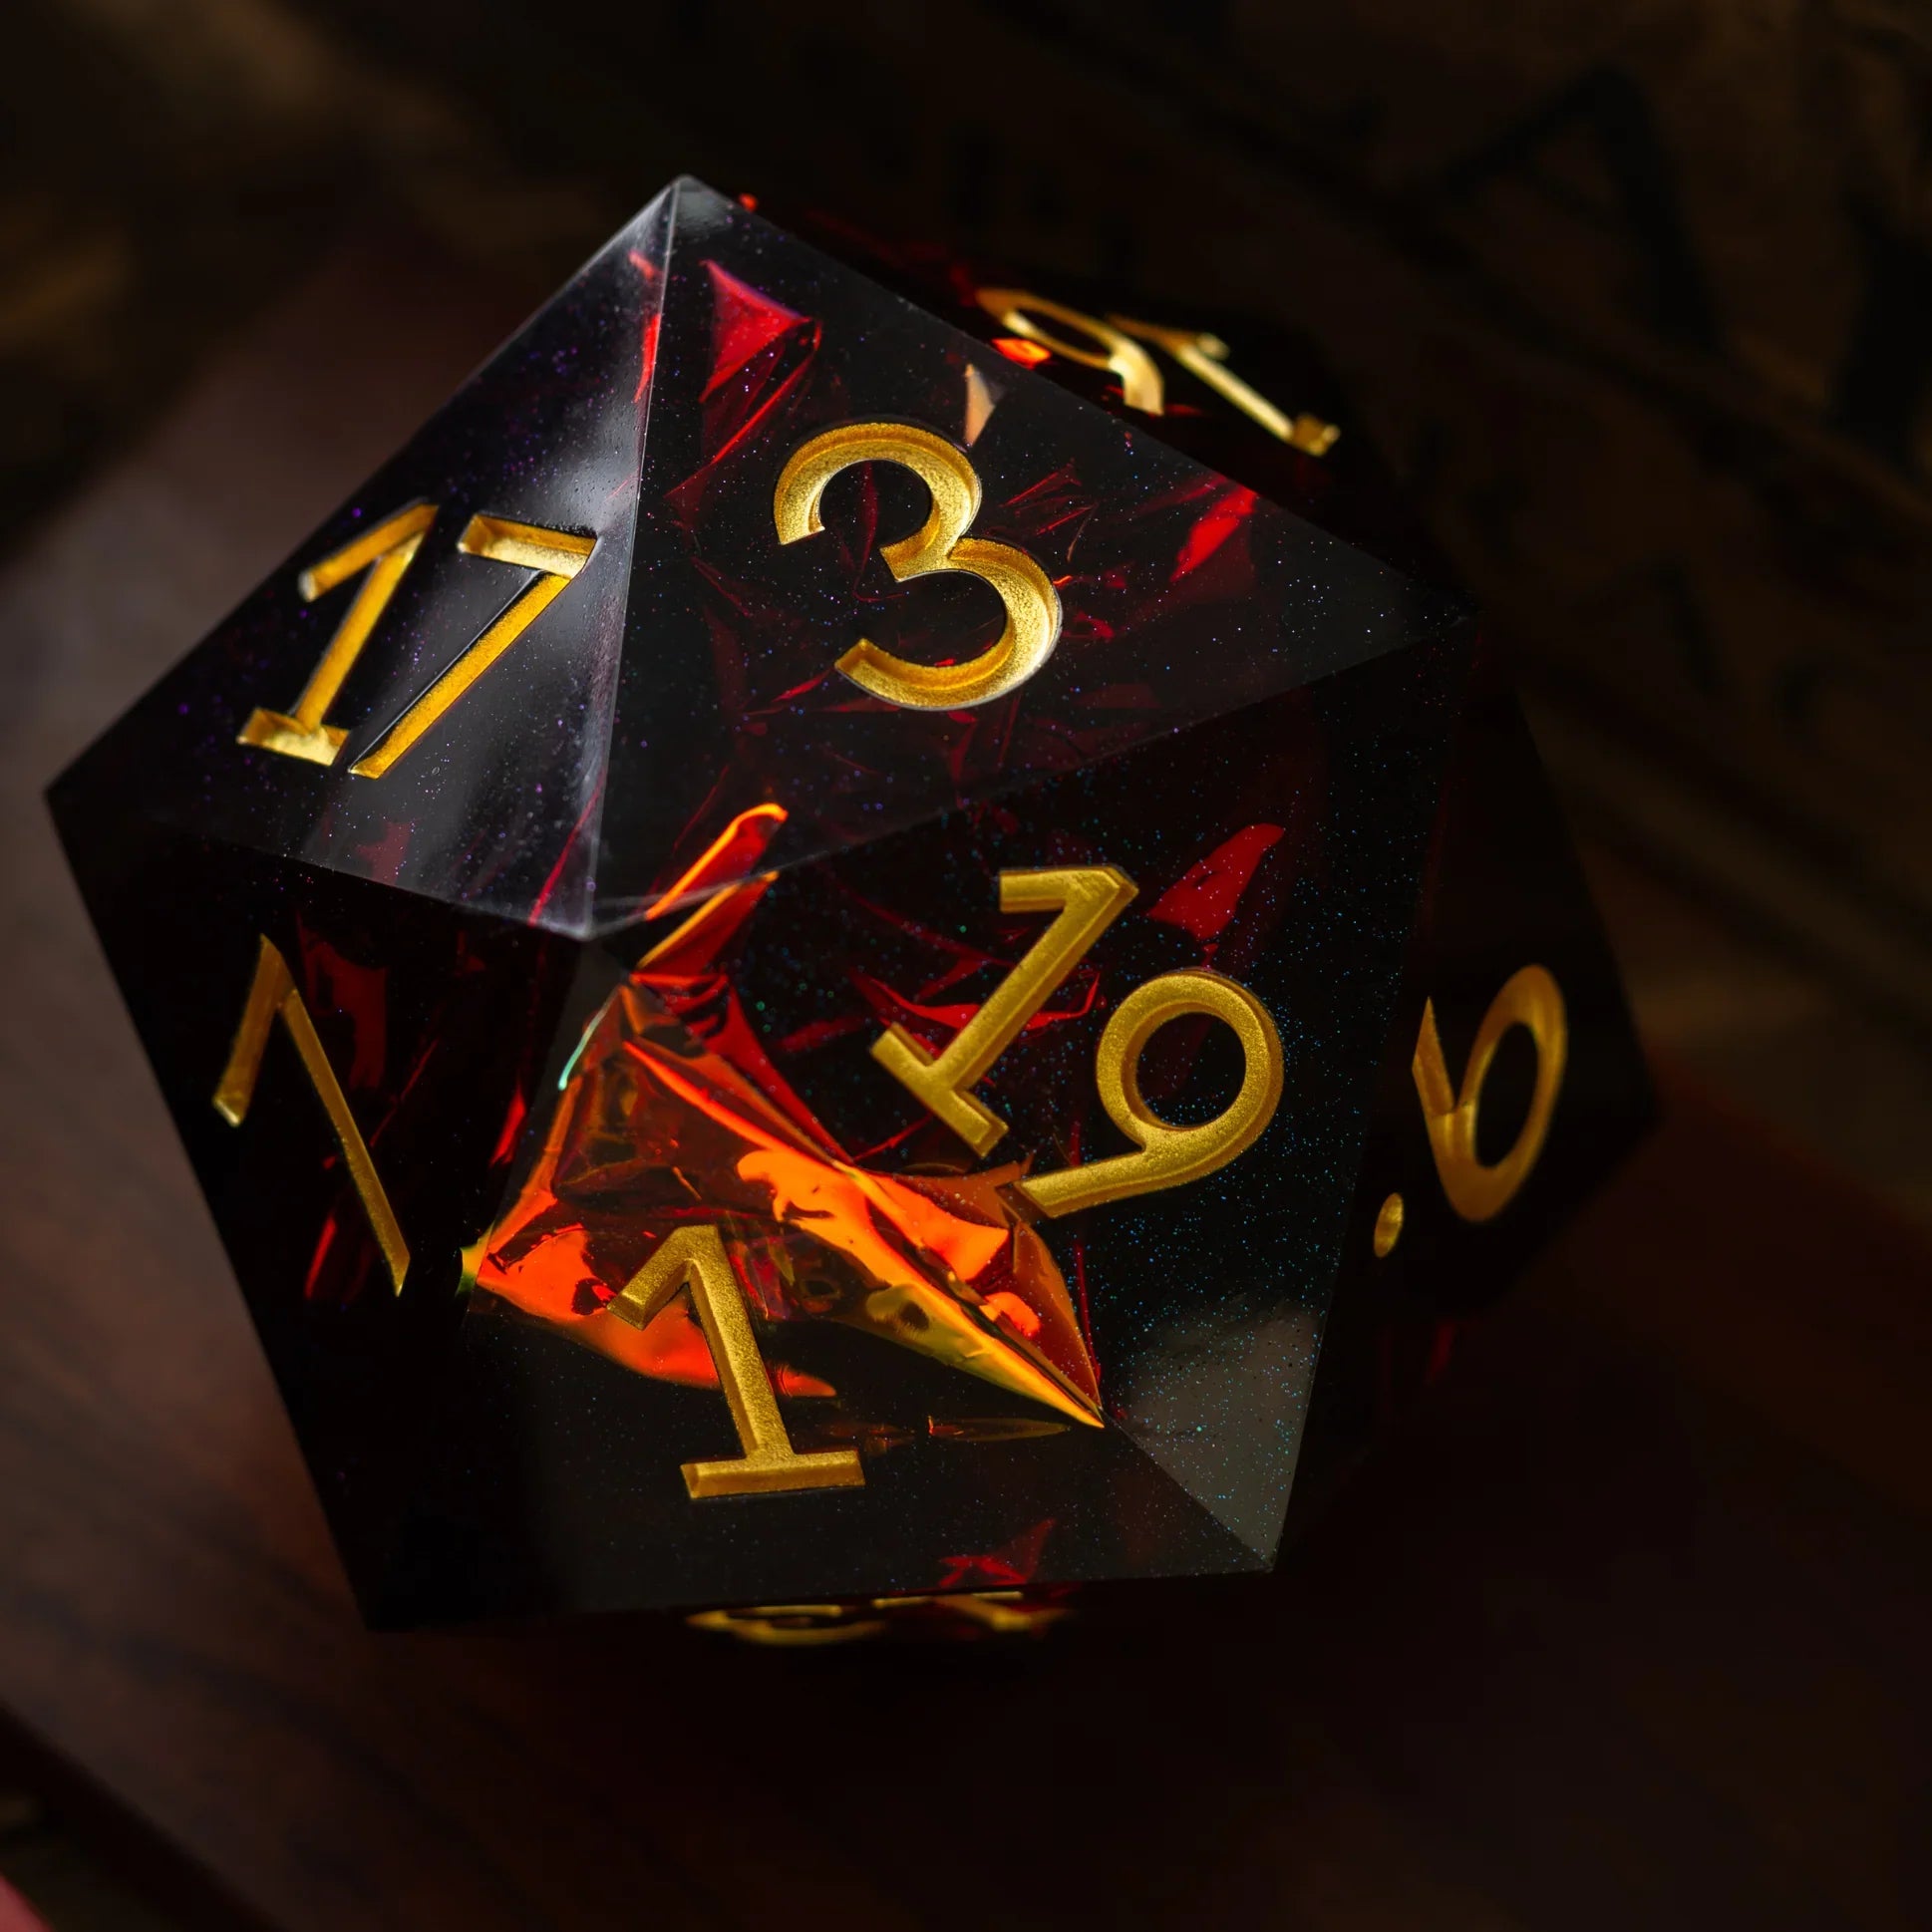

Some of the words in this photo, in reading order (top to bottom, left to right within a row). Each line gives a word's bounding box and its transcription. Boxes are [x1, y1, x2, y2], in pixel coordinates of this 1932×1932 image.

[238, 501, 600, 778] 17
[774, 422, 1063, 712] 3
[870, 865, 1284, 1216] 19
[609, 1226, 865, 1499] 1
